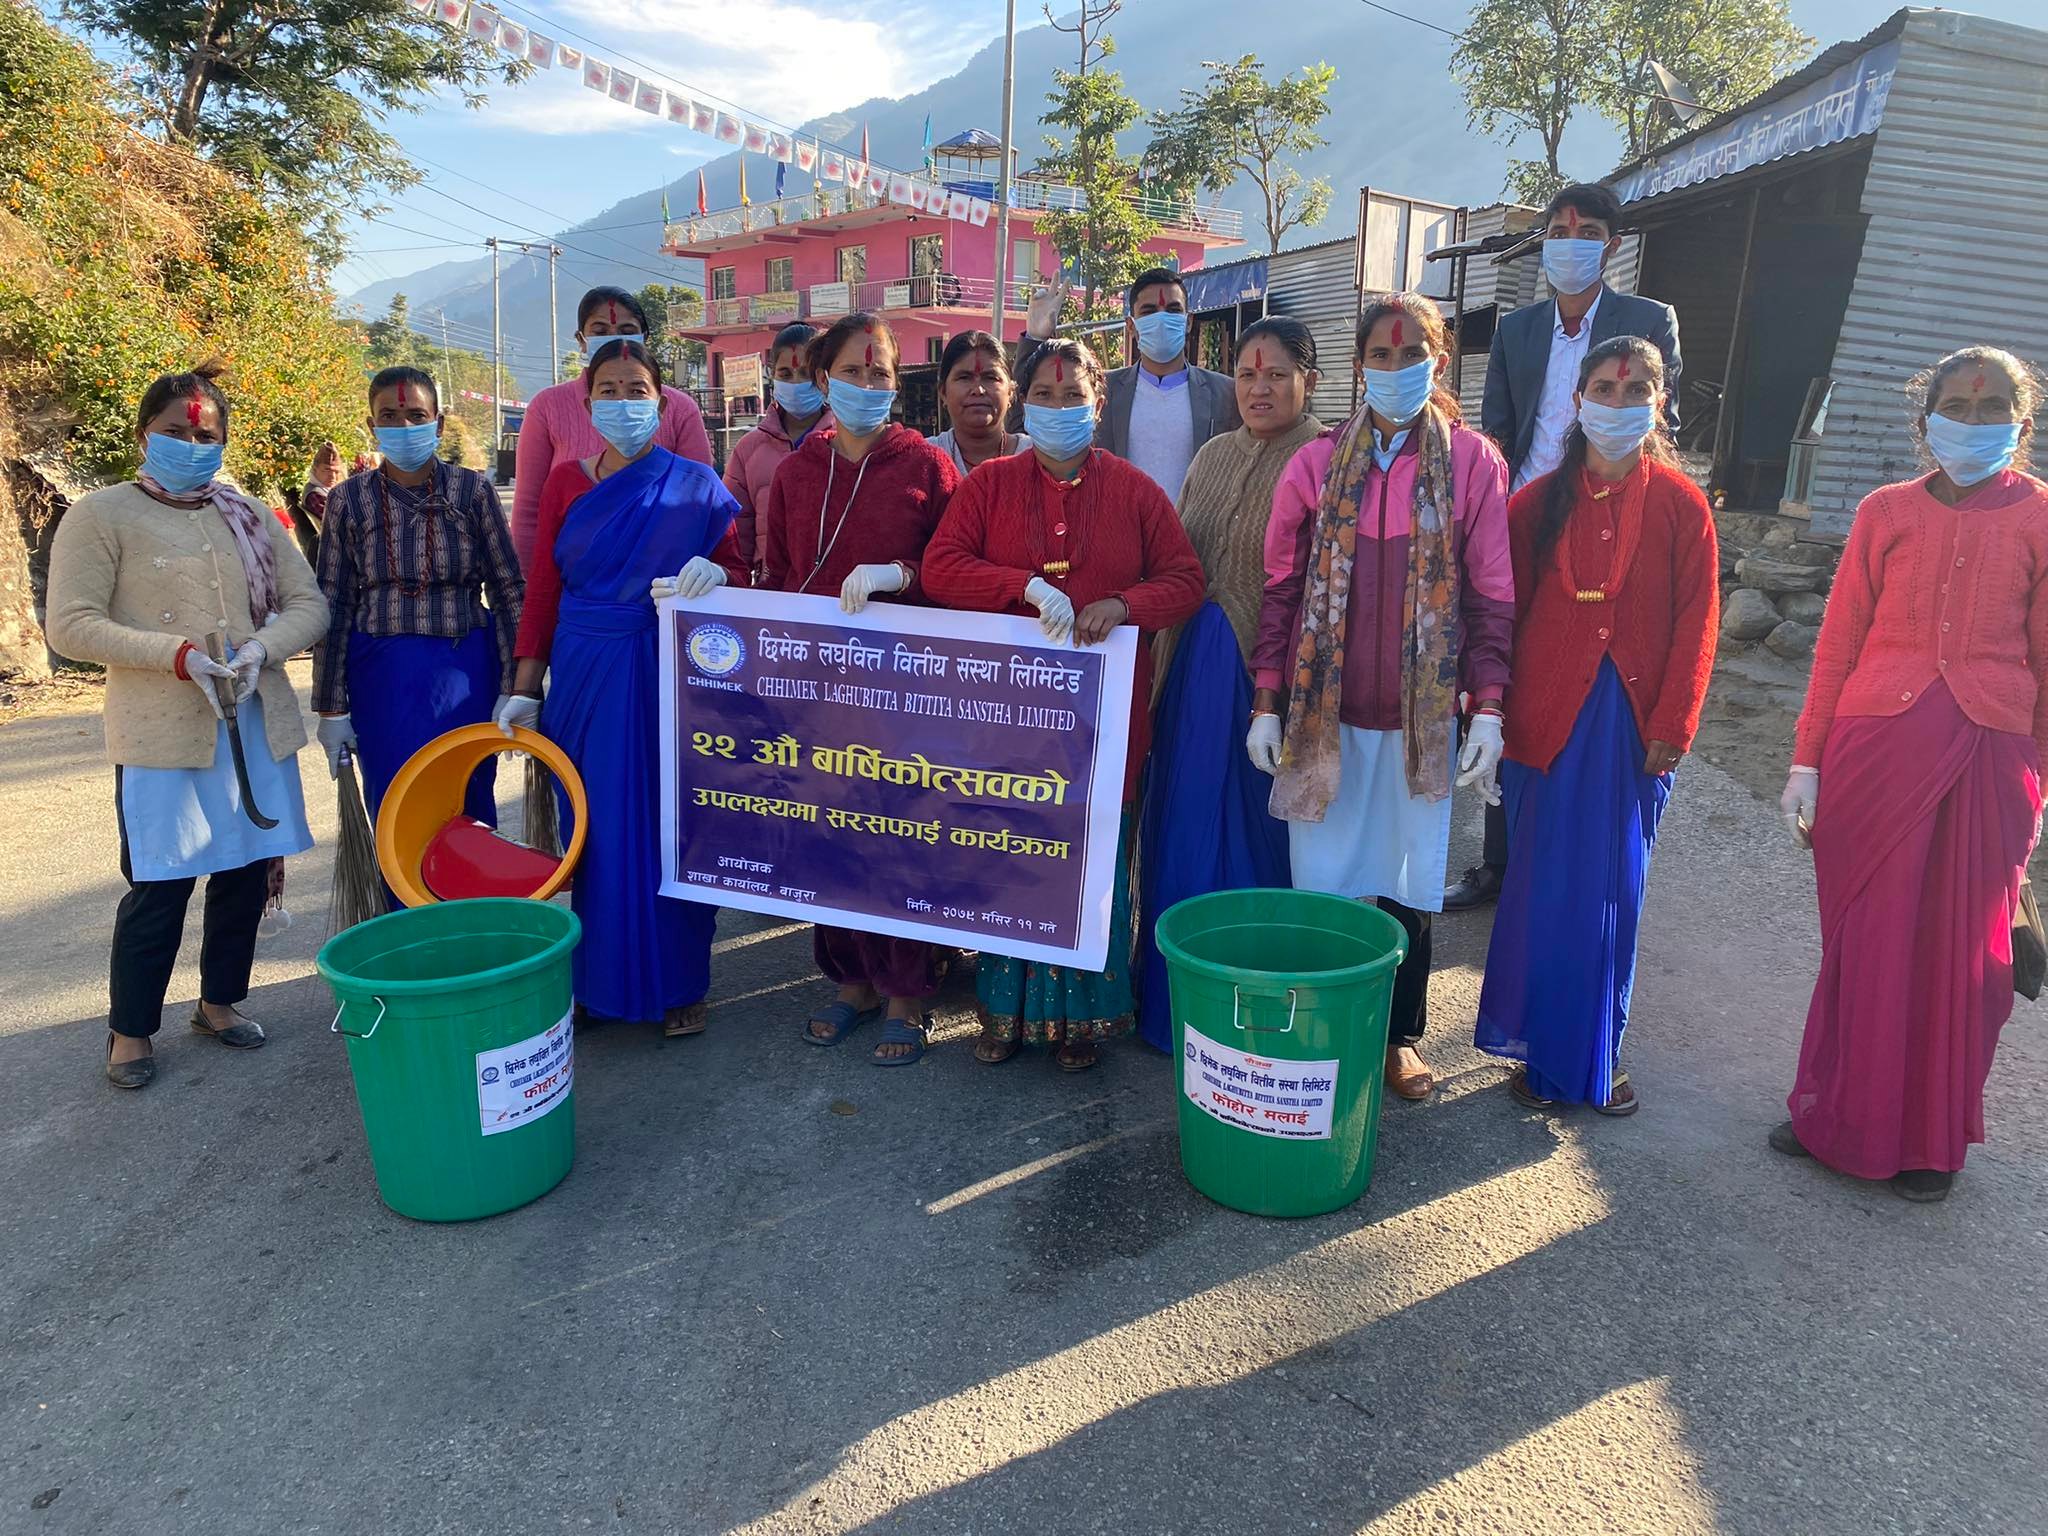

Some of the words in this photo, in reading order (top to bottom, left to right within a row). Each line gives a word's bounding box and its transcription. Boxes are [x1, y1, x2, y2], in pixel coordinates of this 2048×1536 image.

[758, 628, 811, 663] छिमेक
[818, 637, 885, 674] लघुवित्त
[893, 642, 949, 678] वित्तीय
[956, 653, 1001, 684] संस्था
[1009, 655, 1083, 694] लिमिटेड
[687, 676, 744, 693] CHHIMEK
[757, 677, 818, 700] CHHIMEK
[824, 682, 898, 711] LAGHUBITTA
[904, 692, 952, 718] BITTIYA
[957, 699, 1012, 725] SANSTHA
[1018, 705, 1076, 731] LIMITED
[692, 731, 737, 759] २२
[812, 744, 1070, 805] बार्षिकोत्सवको
[692, 788, 819, 822] उपलक्ष्यमा
[826, 808, 942, 845] सरसफाई
[950, 827, 1070, 859] कार्यक्रम
[687, 871, 718, 884] शाखा
[717, 856, 774, 874] आयोजक
[942, 906, 975, 921] २०७९
[1017, 918, 1032, 930] ११
[1039, 921, 1057, 934] गते
[1302, 1077, 1331, 1092] लिमिटेड
[1212, 1091, 1257, 1118] फोहोर
